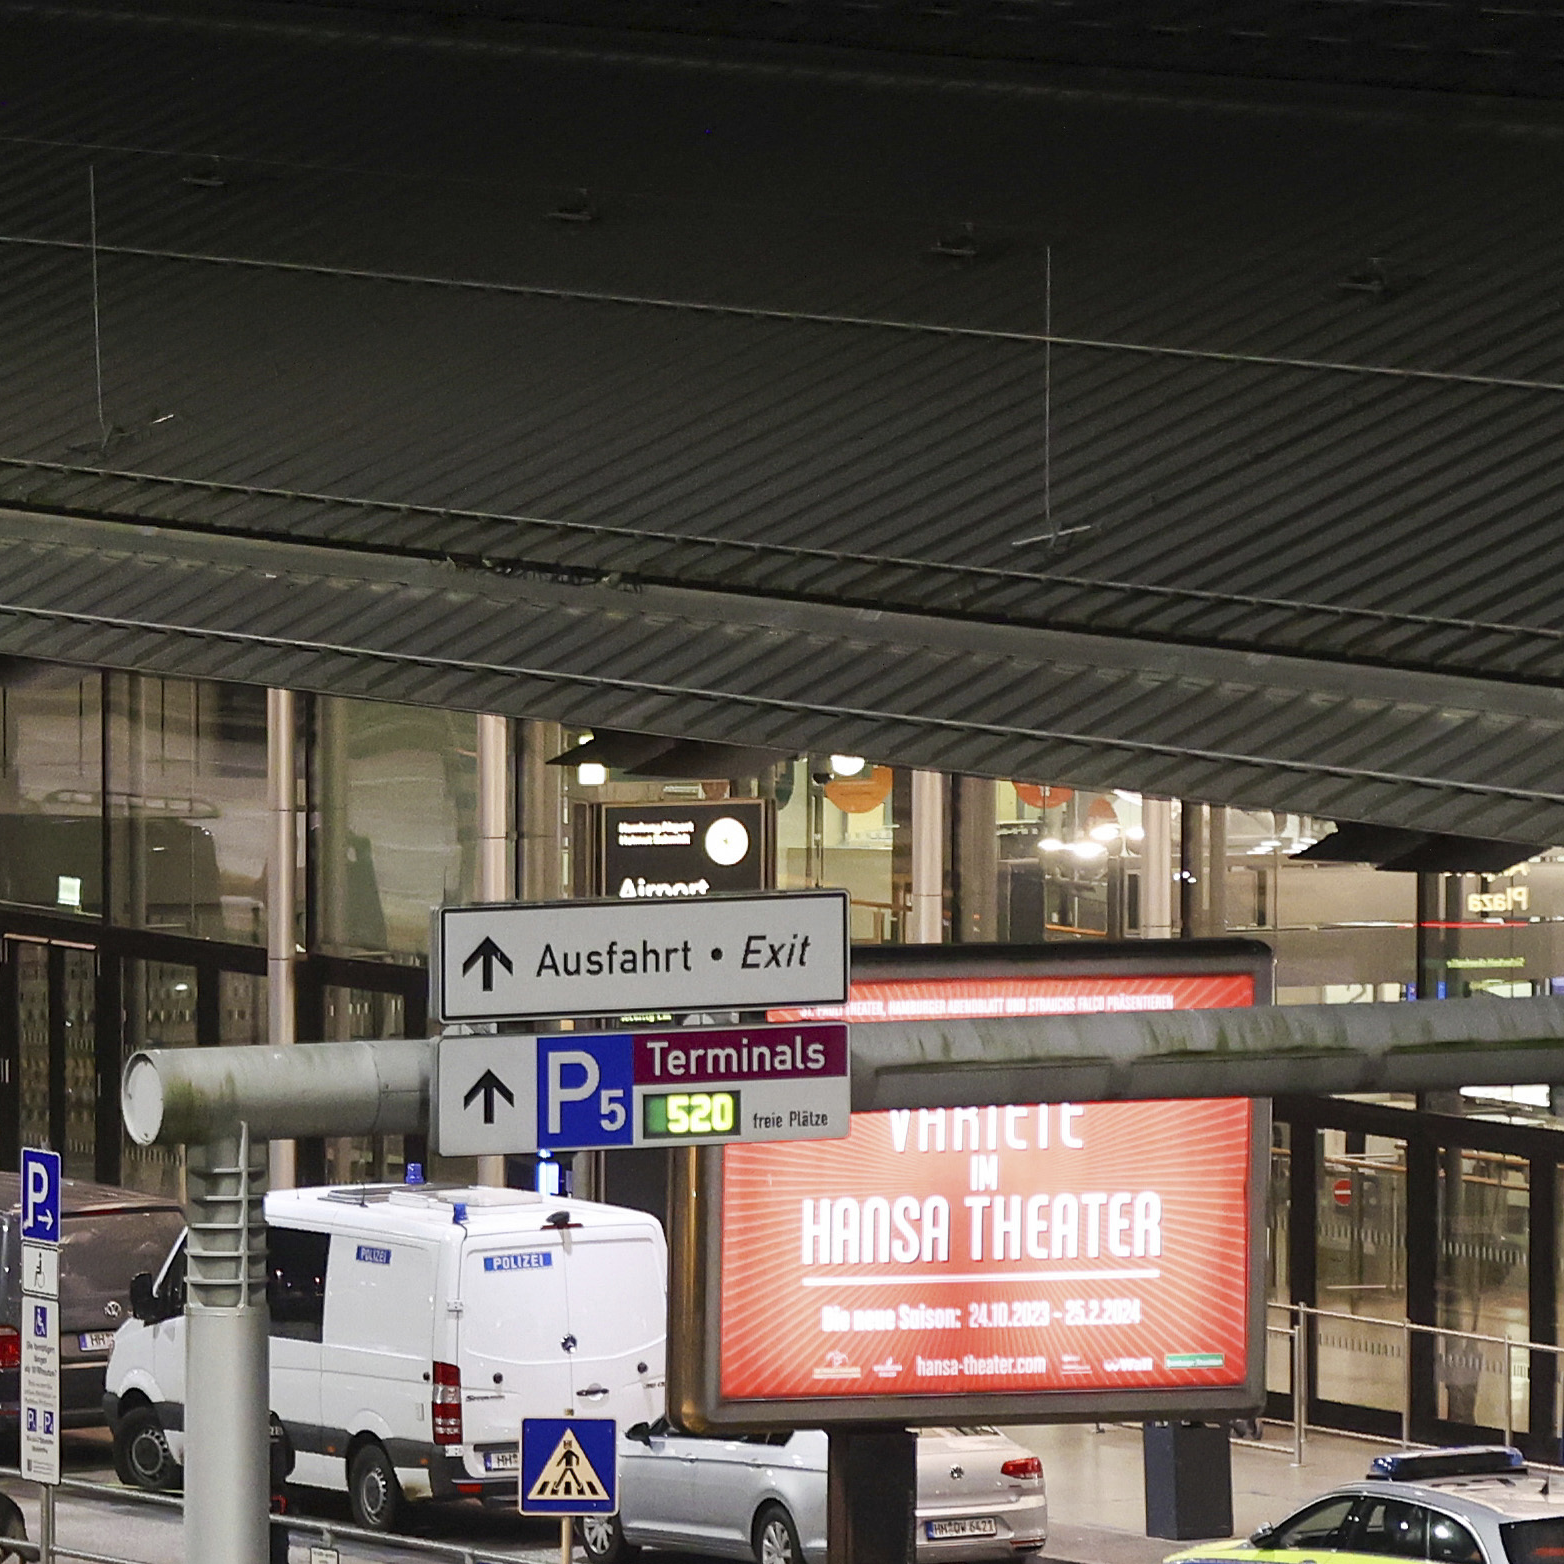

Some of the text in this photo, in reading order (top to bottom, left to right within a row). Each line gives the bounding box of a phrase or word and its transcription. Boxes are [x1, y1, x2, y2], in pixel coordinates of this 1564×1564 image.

[536, 933, 811, 978] Ausfahrt Exit
[646, 1036, 826, 1077] Terminals
[666, 1093, 829, 1134] 520 freie Plätze
[969, 1154, 999, 1191] IM
[27, 1161, 49, 1228] P
[801, 1191, 1162, 1265] HANSA THEATER
[359, 1247, 387, 1264] POLIZEI
[492, 1256, 544, 1271] POLIZEI
[898, 1303, 962, 1329] Saison:
[968, 1301, 1051, 1328] 24.10.2023
[90, 1334, 105, 1346] HH
[915, 1355, 1047, 1377] hansa-theater.com
[498, 1454, 512, 1467] HH
